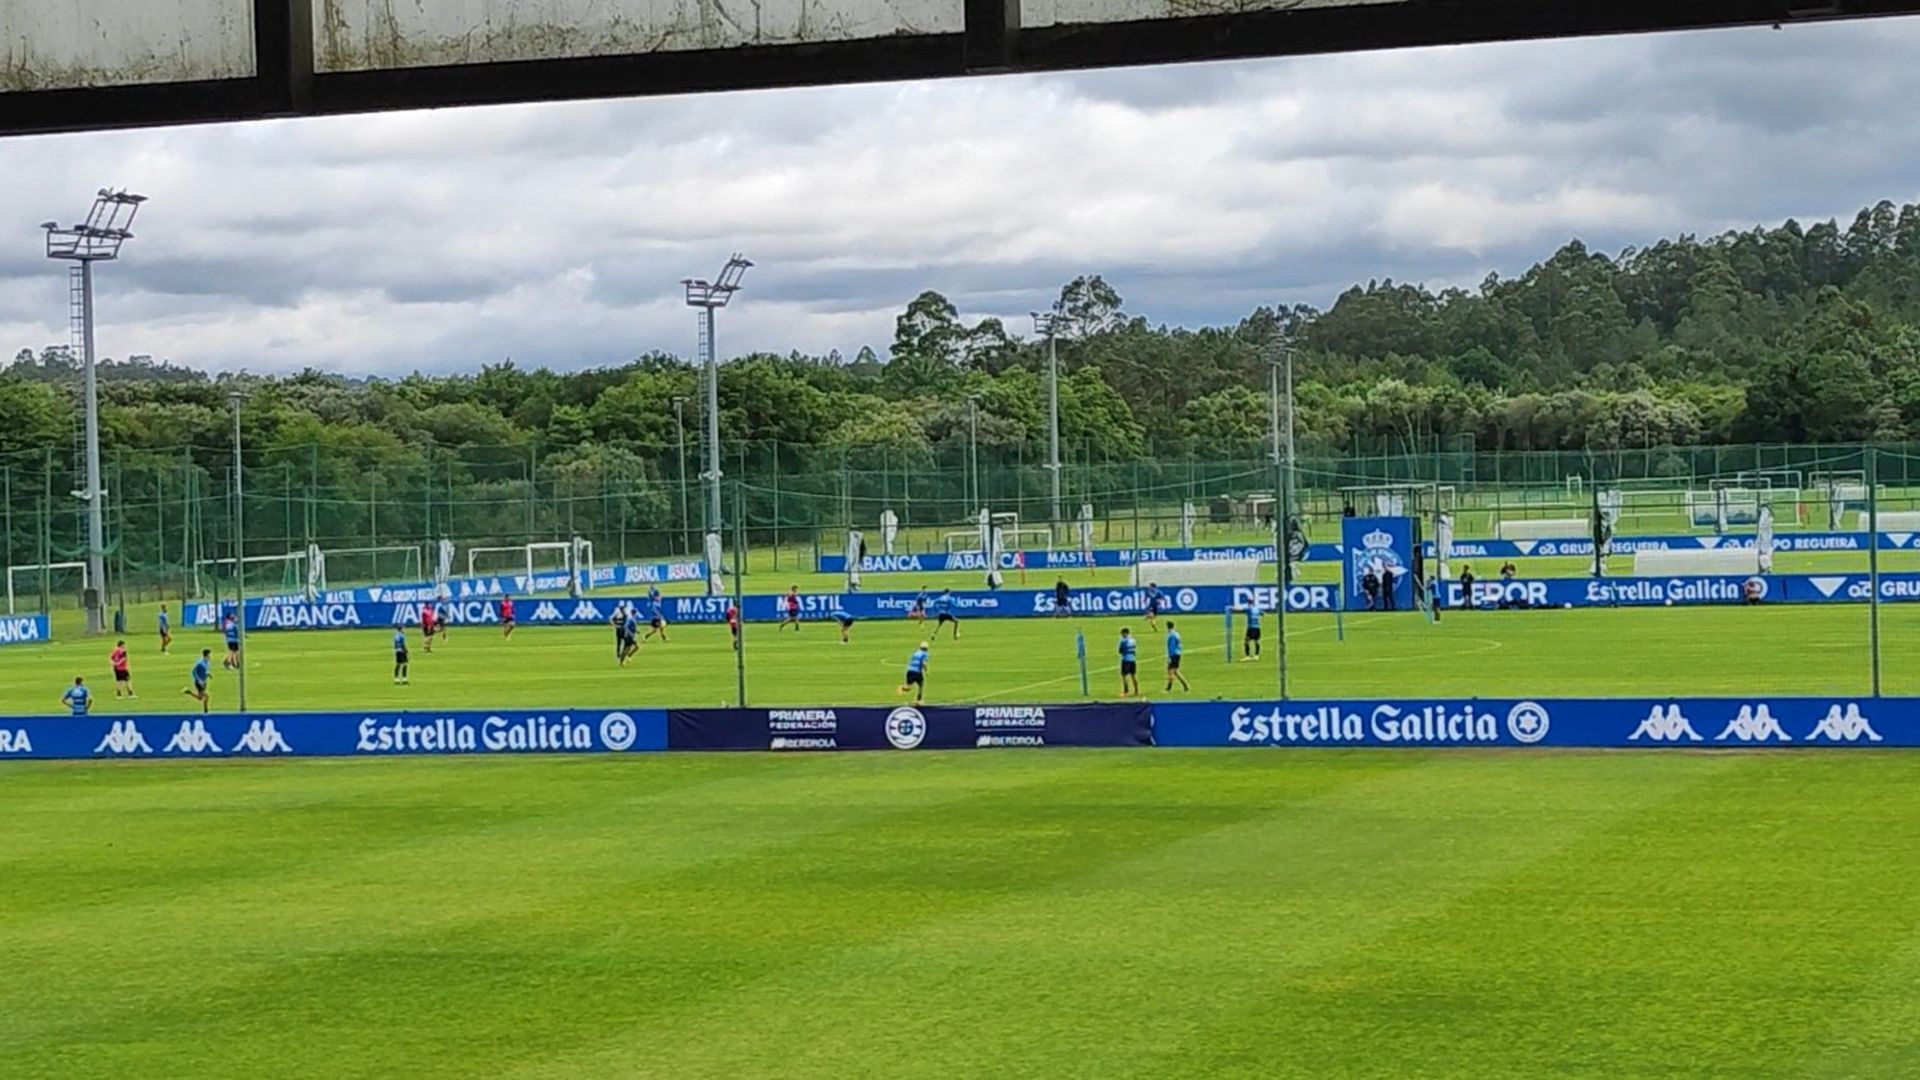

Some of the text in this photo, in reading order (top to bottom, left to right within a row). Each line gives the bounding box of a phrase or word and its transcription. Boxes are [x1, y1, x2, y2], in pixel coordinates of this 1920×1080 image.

[1794, 537, 1858, 549] REGUEIRA
[1048, 551, 1096, 563] MASTIL
[1666, 579, 1739, 600] Galicia
[265, 604, 361, 627] ABANCA
[769, 710, 836, 721] PRIMERA
[975, 707, 1046, 718] PRIMERA
[769, 721, 837, 730] FEDERACIÓN
[975, 718, 1046, 727] FEDERACIÓN
[1228, 706, 1365, 742] Estrella
[1370, 704, 1499, 742] Galicia
[356, 717, 476, 750] Estrella
[481, 716, 592, 749] Galicia
[785, 738, 837, 749] IBERDROLA
[991, 735, 1045, 746] IBERDROLA
